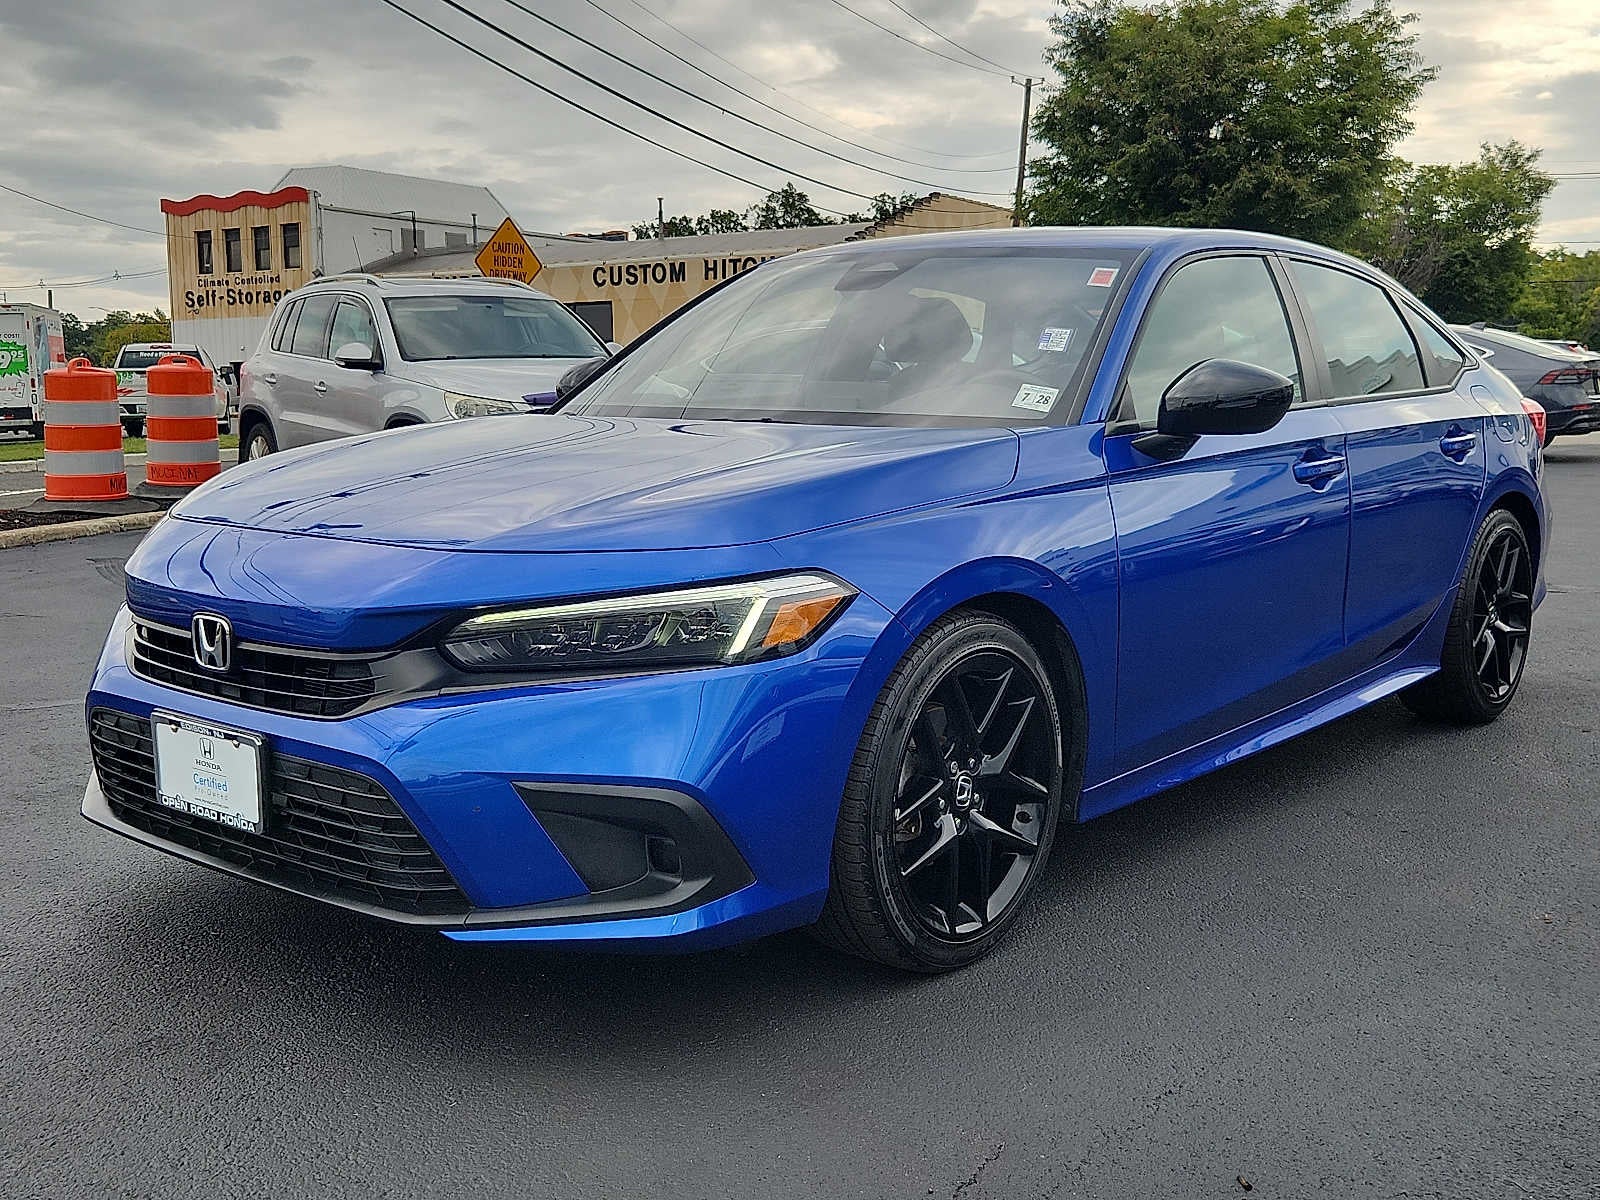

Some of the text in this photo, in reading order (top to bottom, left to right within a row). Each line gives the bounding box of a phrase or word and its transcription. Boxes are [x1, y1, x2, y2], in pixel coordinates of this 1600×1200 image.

[491, 241, 525, 255] CAUTION
[493, 256, 524, 269] HIDDEN
[197, 274, 280, 288] Climate Controlled
[592, 261, 686, 288] CUSTOM
[1021, 392, 1052, 405] 7 28
[194, 759, 223, 771] HONDA
[193, 773, 228, 792] Certified
[161, 795, 188, 812] OPEN
[190, 804, 218, 821] ROAD
[219, 812, 256, 833] HONDA
